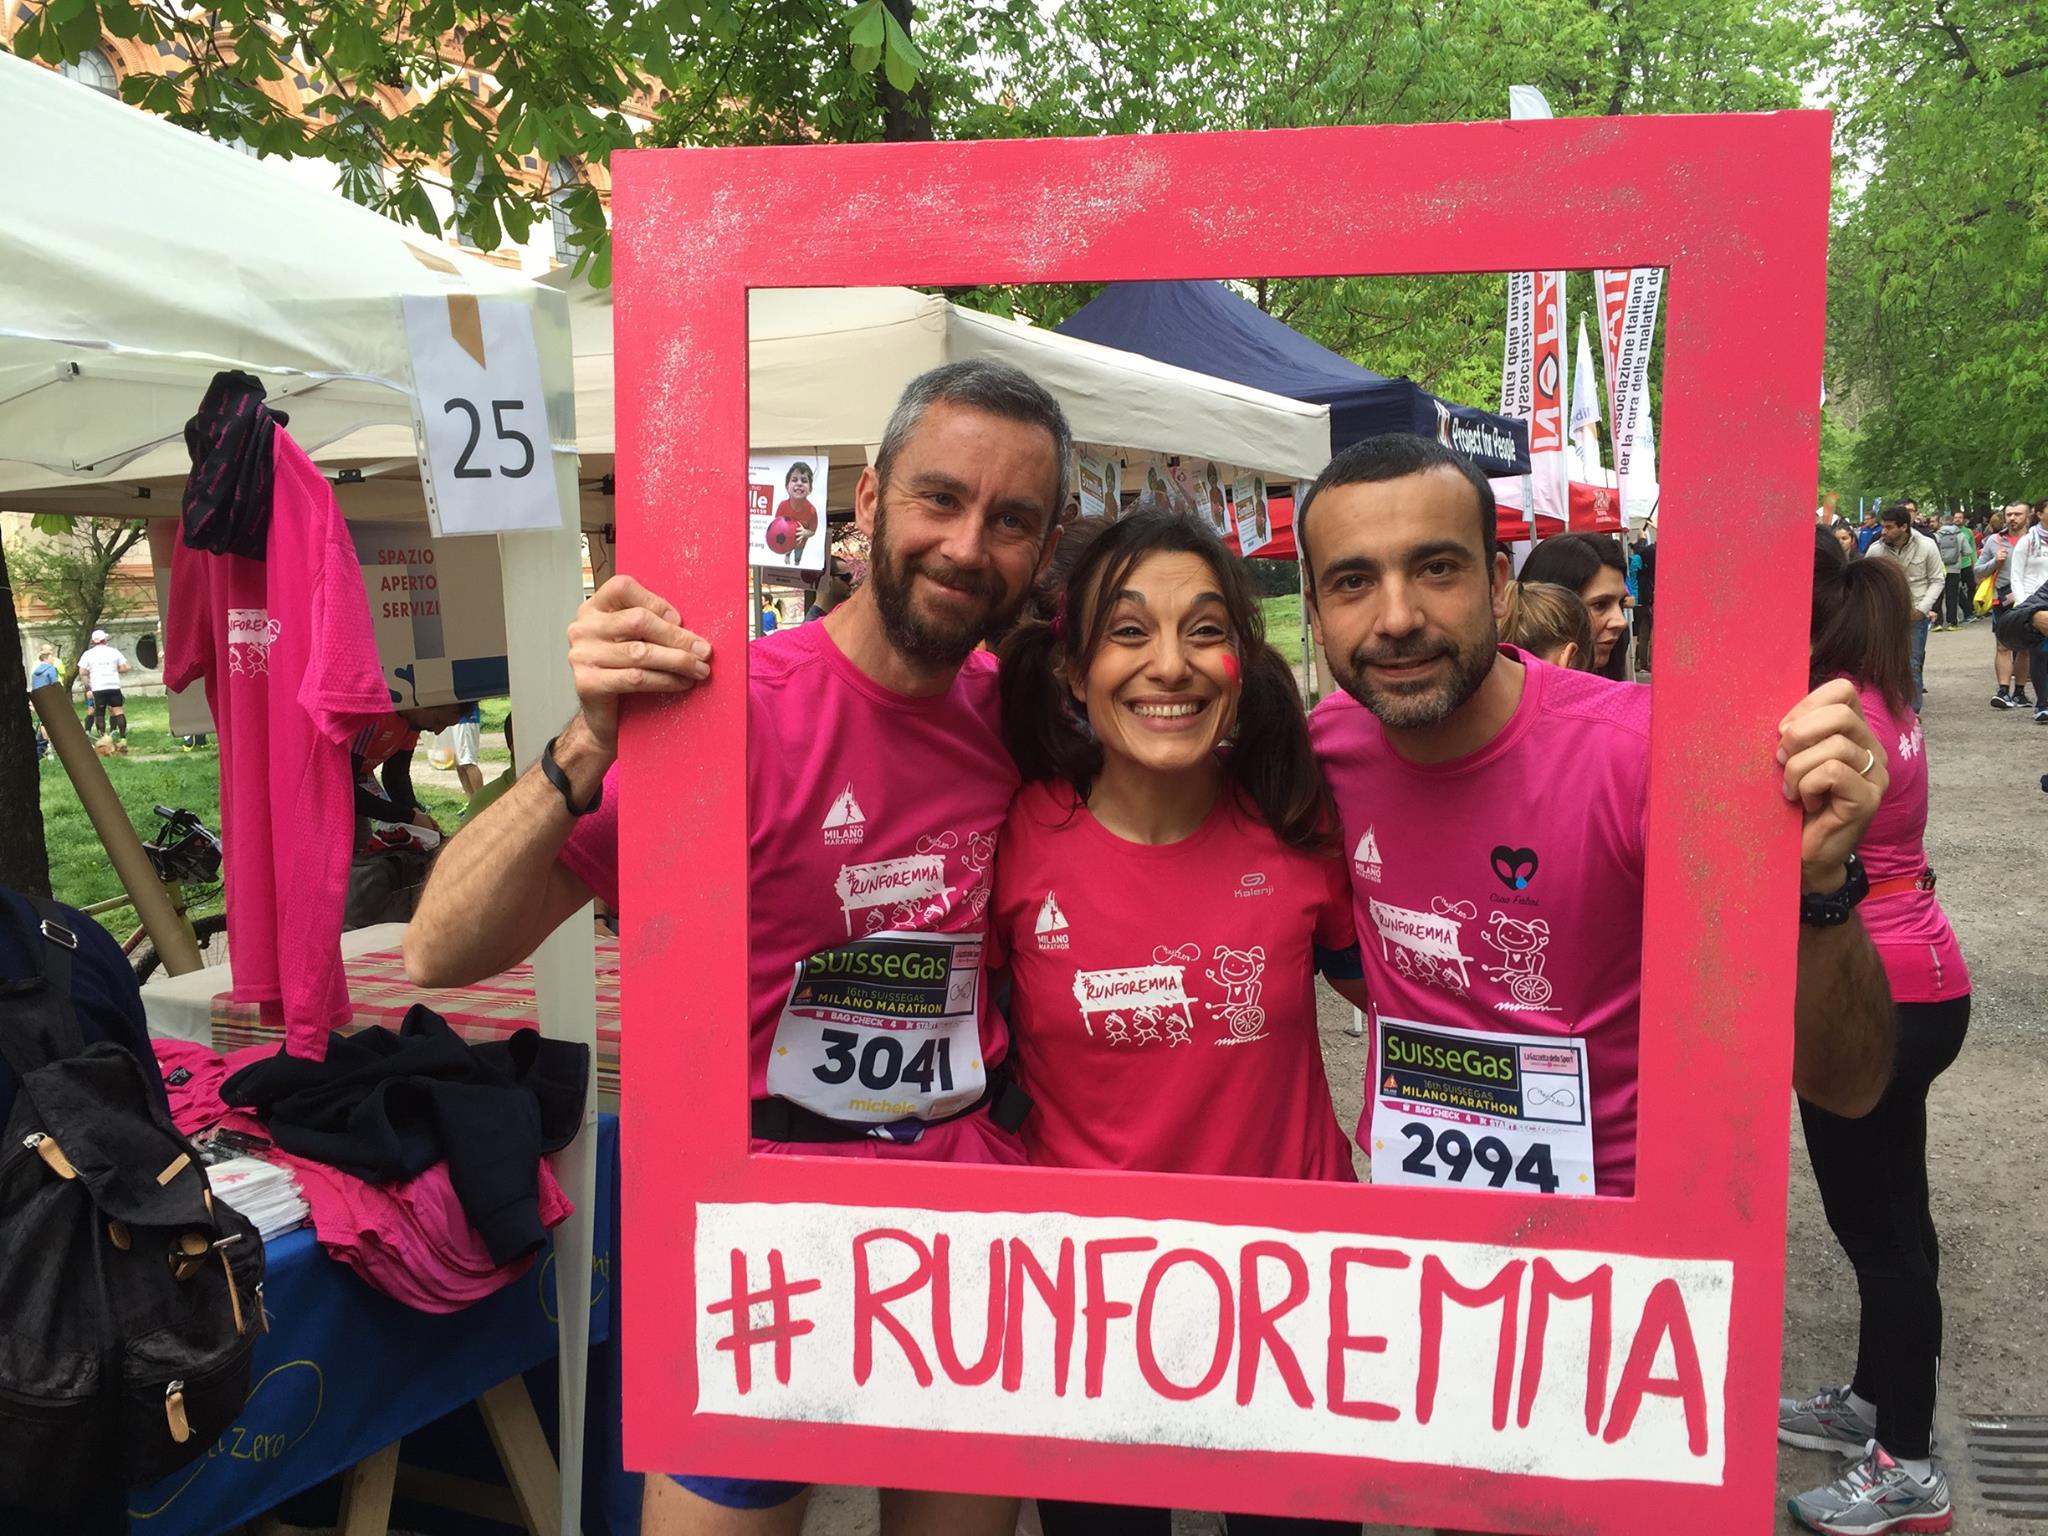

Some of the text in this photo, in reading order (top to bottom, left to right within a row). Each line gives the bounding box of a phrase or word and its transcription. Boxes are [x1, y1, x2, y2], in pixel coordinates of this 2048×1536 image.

[1623, 275, 1645, 335] italiana
[1638, 290, 1657, 352] malattia
[1631, 355, 1647, 392] della
[1626, 396, 1640, 429] cura
[444, 398, 535, 479] 25
[1452, 417, 1517, 469] Project for People
[1621, 434, 1634, 447] la
[1619, 452, 1632, 475] per
[378, 549, 435, 566] SPAZIO
[380, 574, 438, 592] APERTO
[382, 600, 440, 618] SERVIZI
[824, 828, 864, 839] MILANO
[824, 837, 864, 846] MARATHON
[1234, 885, 1274, 898] Kalenji
[1037, 934, 1069, 944] MILANO
[1038, 942, 1070, 950] MARATHON
[817, 992, 943, 1014] MILANO MARATHON
[847, 985, 926, 1003] 16th SUISSEGAS
[831, 1011, 851, 1021] BAG
[852, 1014, 884, 1027] CHECK
[813, 1028, 954, 1093] 3041
[1402, 1085, 1448, 1103] MILANO
[1450, 1094, 1518, 1115] MARATHON
[1442, 1083, 1494, 1101] SUISSEGAS
[849, 1097, 918, 1115] michele
[1415, 1106, 1432, 1116] BAG
[1432, 1109, 1460, 1121] CHECK
[1465, 1114, 1472, 1122] 4
[1400, 1122, 1560, 1194] 2994
[229, 1427, 286, 1462] Zero
